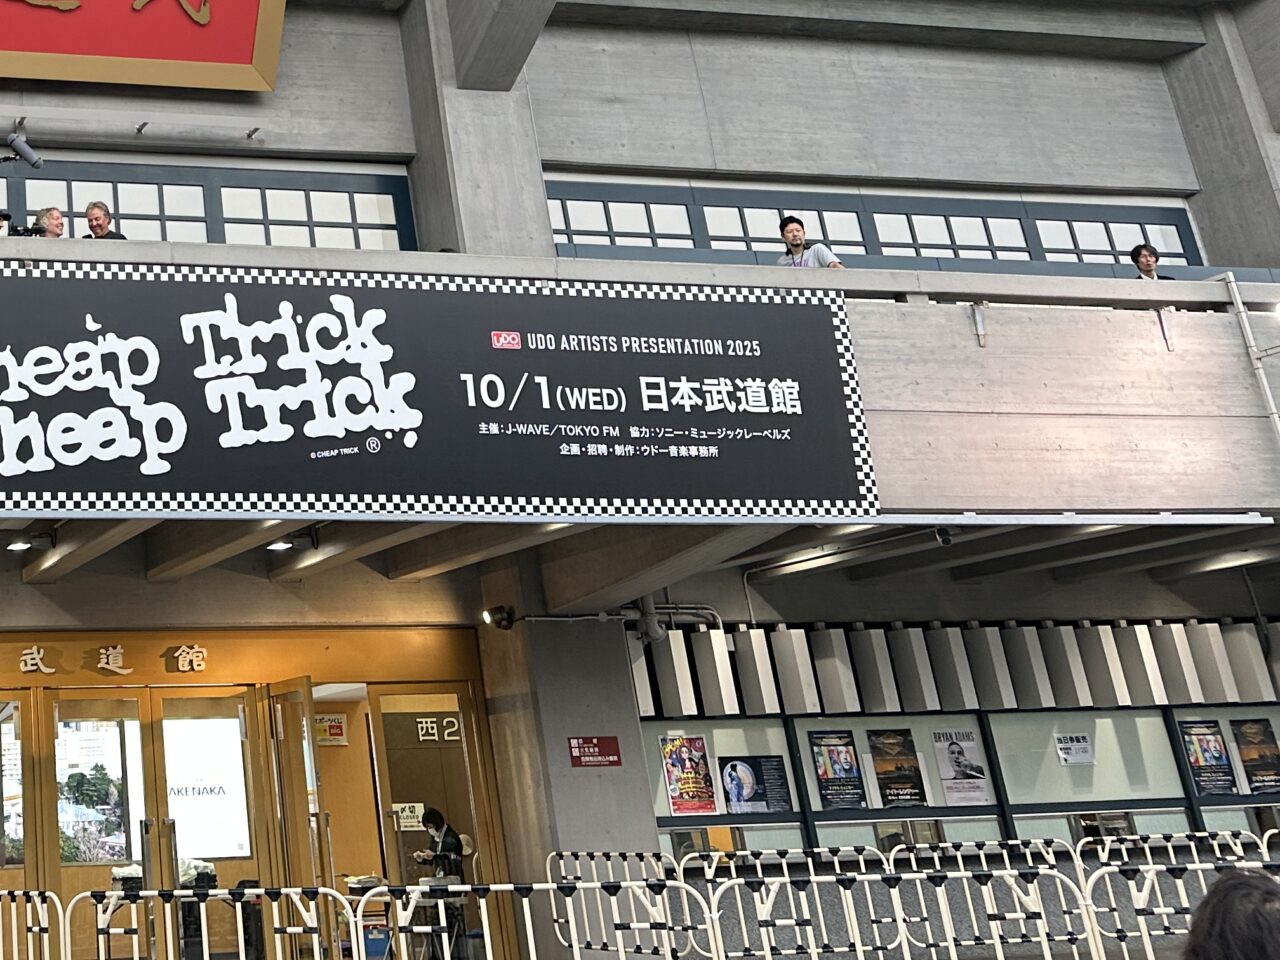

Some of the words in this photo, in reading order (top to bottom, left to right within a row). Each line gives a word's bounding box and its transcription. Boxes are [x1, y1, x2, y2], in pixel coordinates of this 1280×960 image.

[181, 293, 393, 378] Trick
[527, 333, 556, 350] UDO
[560, 335, 618, 352] ARTISTS
[622, 337, 724, 356] PRESENTATION
[726, 340, 761, 357] 2025
[204, 365, 422, 448] Trick
[639, 375, 803, 415] 日本武道館
[603, 425, 620, 437] FM
[316, 450, 338, 458] CHEAP
[339, 447, 359, 455] TRICK
[933, 731, 954, 742] BRYAN
[955, 731, 974, 742] ADAMS
